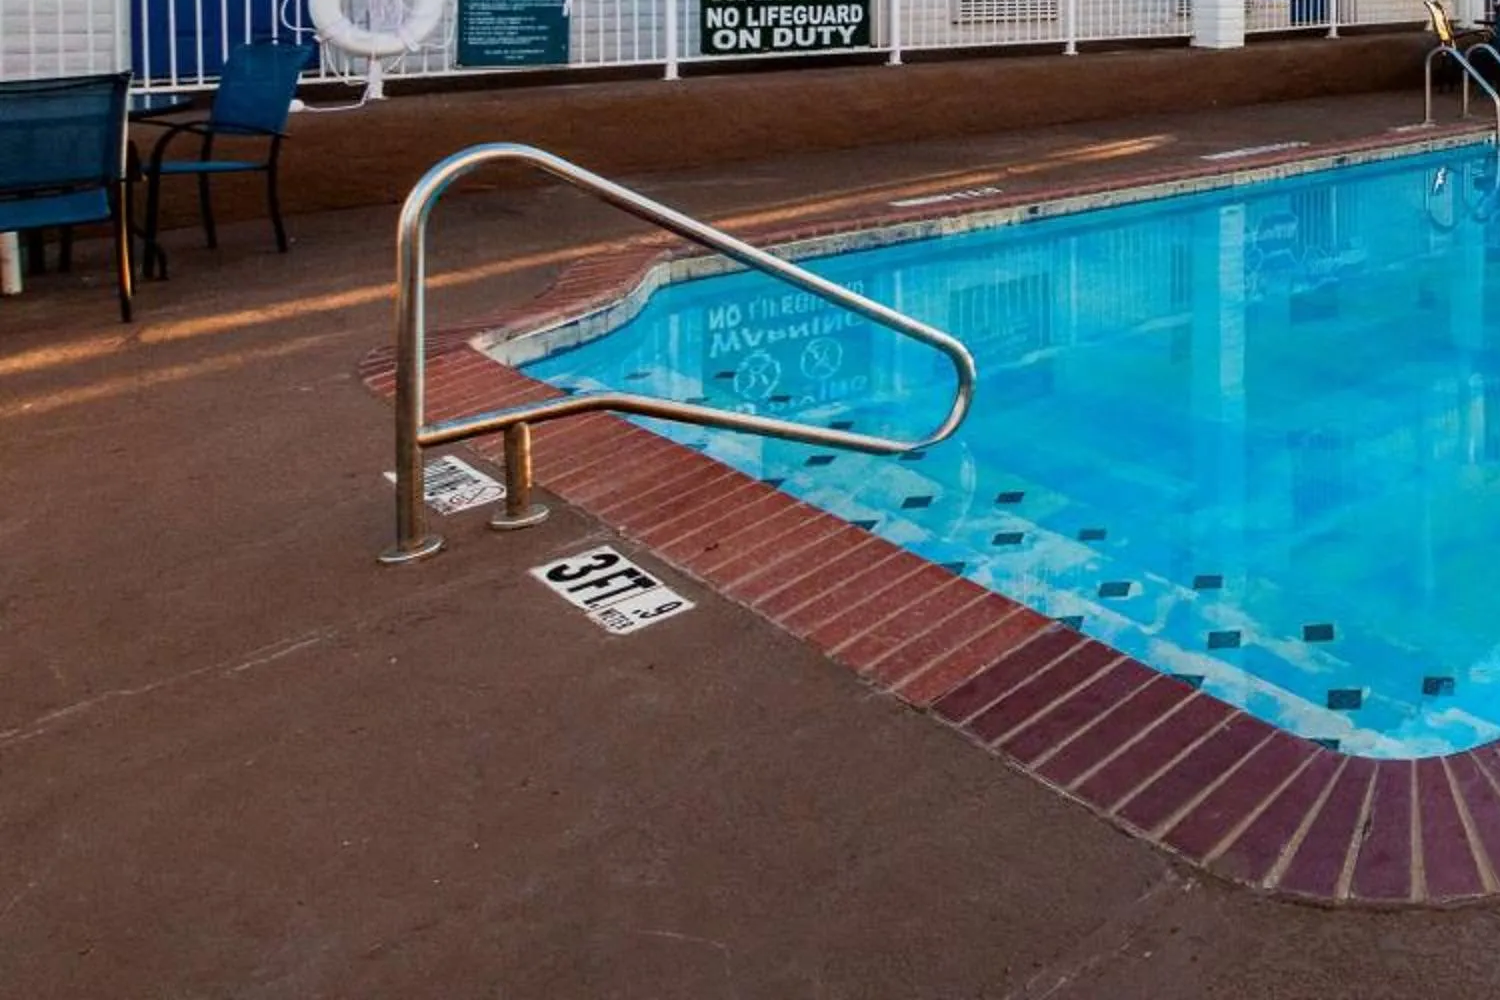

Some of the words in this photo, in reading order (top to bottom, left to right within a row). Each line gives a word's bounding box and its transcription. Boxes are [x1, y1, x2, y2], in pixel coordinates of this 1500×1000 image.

[706, 7, 740, 28] NO
[747, 4, 863, 27] LIFEGUARD
[712, 29, 761, 49] ON
[773, 25, 857, 47] DUTY
